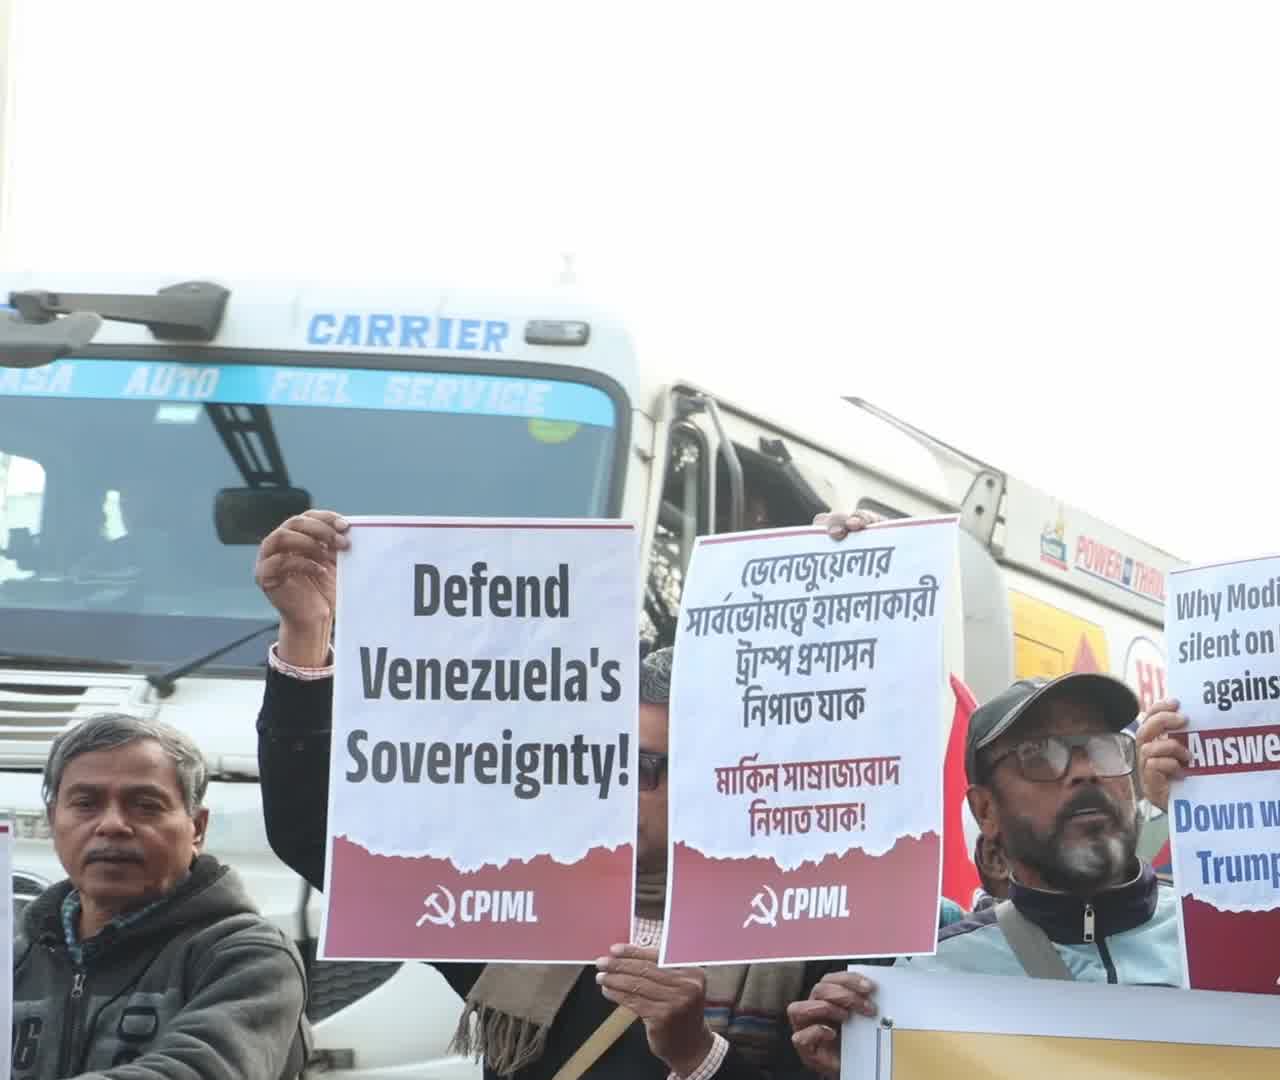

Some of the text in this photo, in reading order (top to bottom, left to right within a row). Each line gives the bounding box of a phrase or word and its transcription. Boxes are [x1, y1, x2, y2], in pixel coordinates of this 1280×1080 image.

[307, 313, 509, 354] CARRIER
[124, 366, 220, 398] AUTO
[265, 371, 351, 406] FUEL
[383, 377, 550, 414] SERVICE
[413, 561, 569, 617] Defend
[741, 546, 896, 592] ভেনেজুয়েলার
[685, 575, 939, 637] সার্বভৌমত্বে হামলাকারী
[1176, 589, 1222, 621] Why
[735, 638, 878, 686] ট্রাম্প প্রশাসন
[1178, 630, 1241, 663] silent
[1244, 630, 1274, 654] on
[359, 646, 621, 702] Venezuela's
[742, 684, 866, 728] নিপাত যাক
[346, 728, 630, 799] Sovereignty!
[715, 753, 901, 797] মার্কিন সাম্রাজ্যবাদ
[749, 798, 867, 839] নিপাত যাক!
[1174, 798, 1255, 833] Down
[460, 889, 537, 923] CPIML
[781, 886, 849, 920] CPIML
